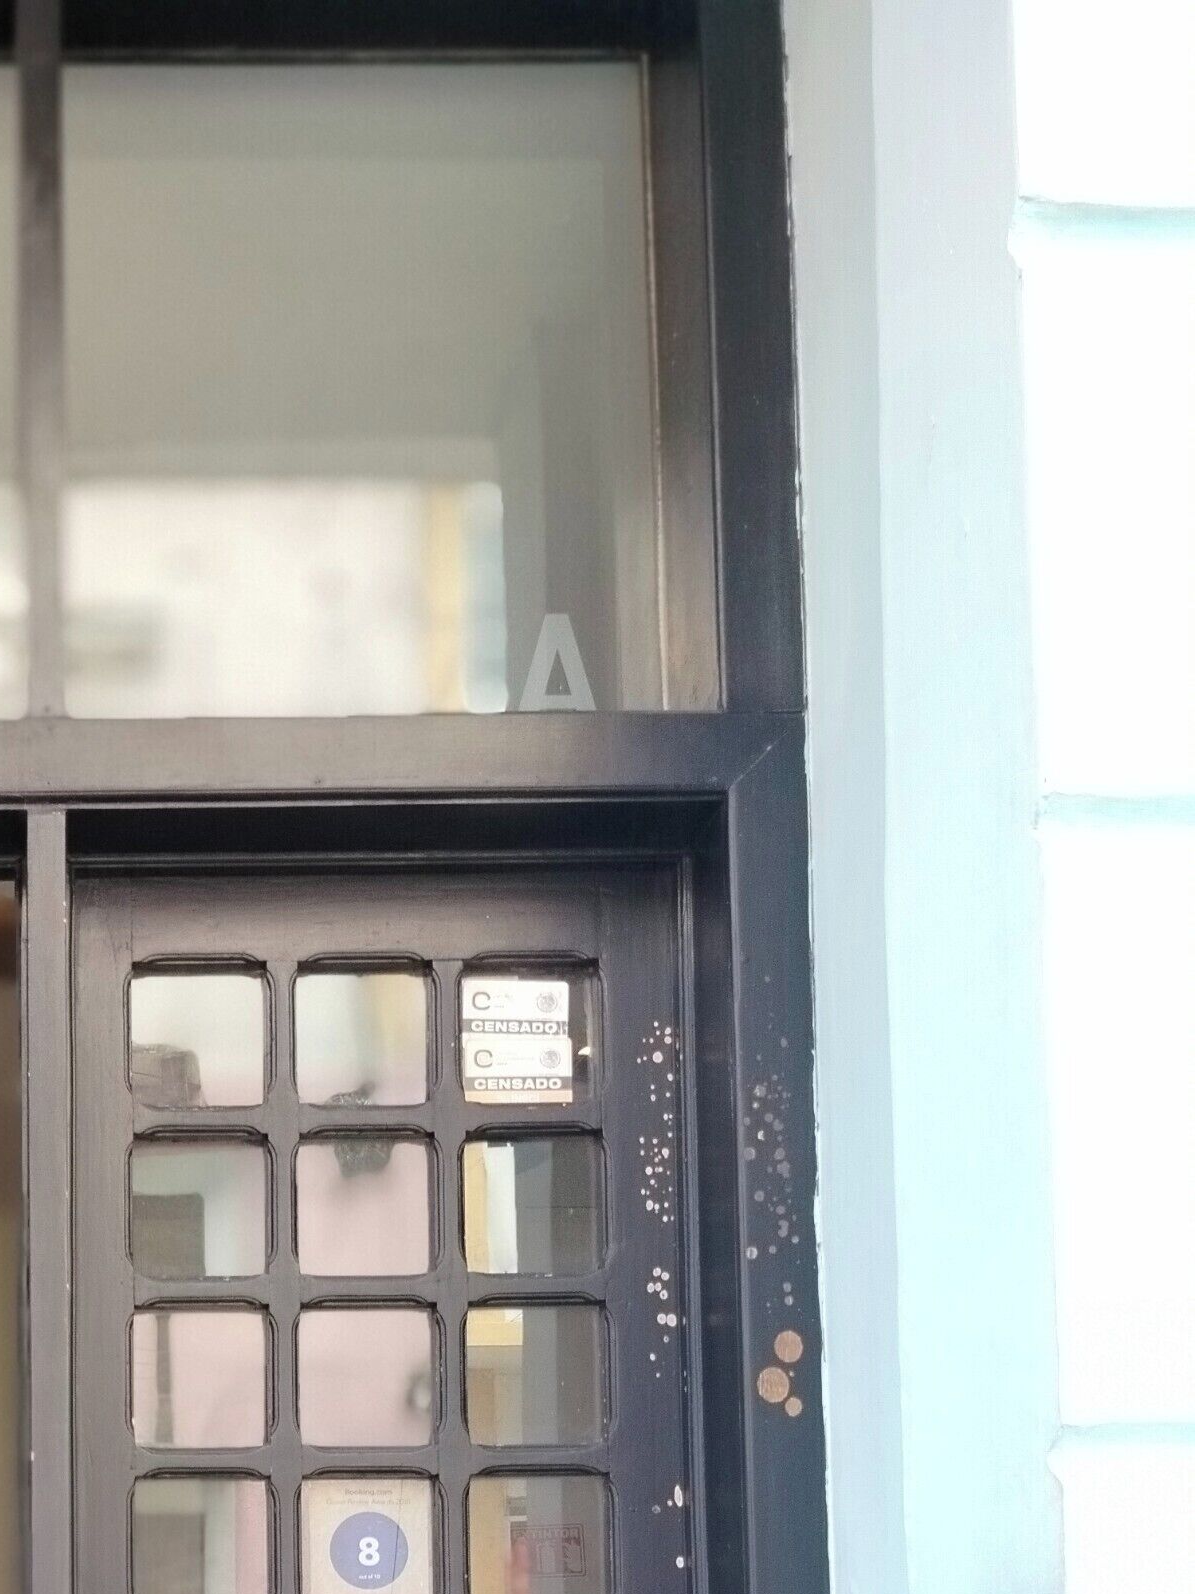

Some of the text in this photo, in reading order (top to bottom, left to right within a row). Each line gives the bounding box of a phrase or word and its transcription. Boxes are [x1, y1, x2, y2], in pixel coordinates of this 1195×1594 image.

[471, 1020, 558, 1034] CENSADO
[474, 1078, 562, 1090] CENSADO
[358, 1537, 380, 1567] 8
